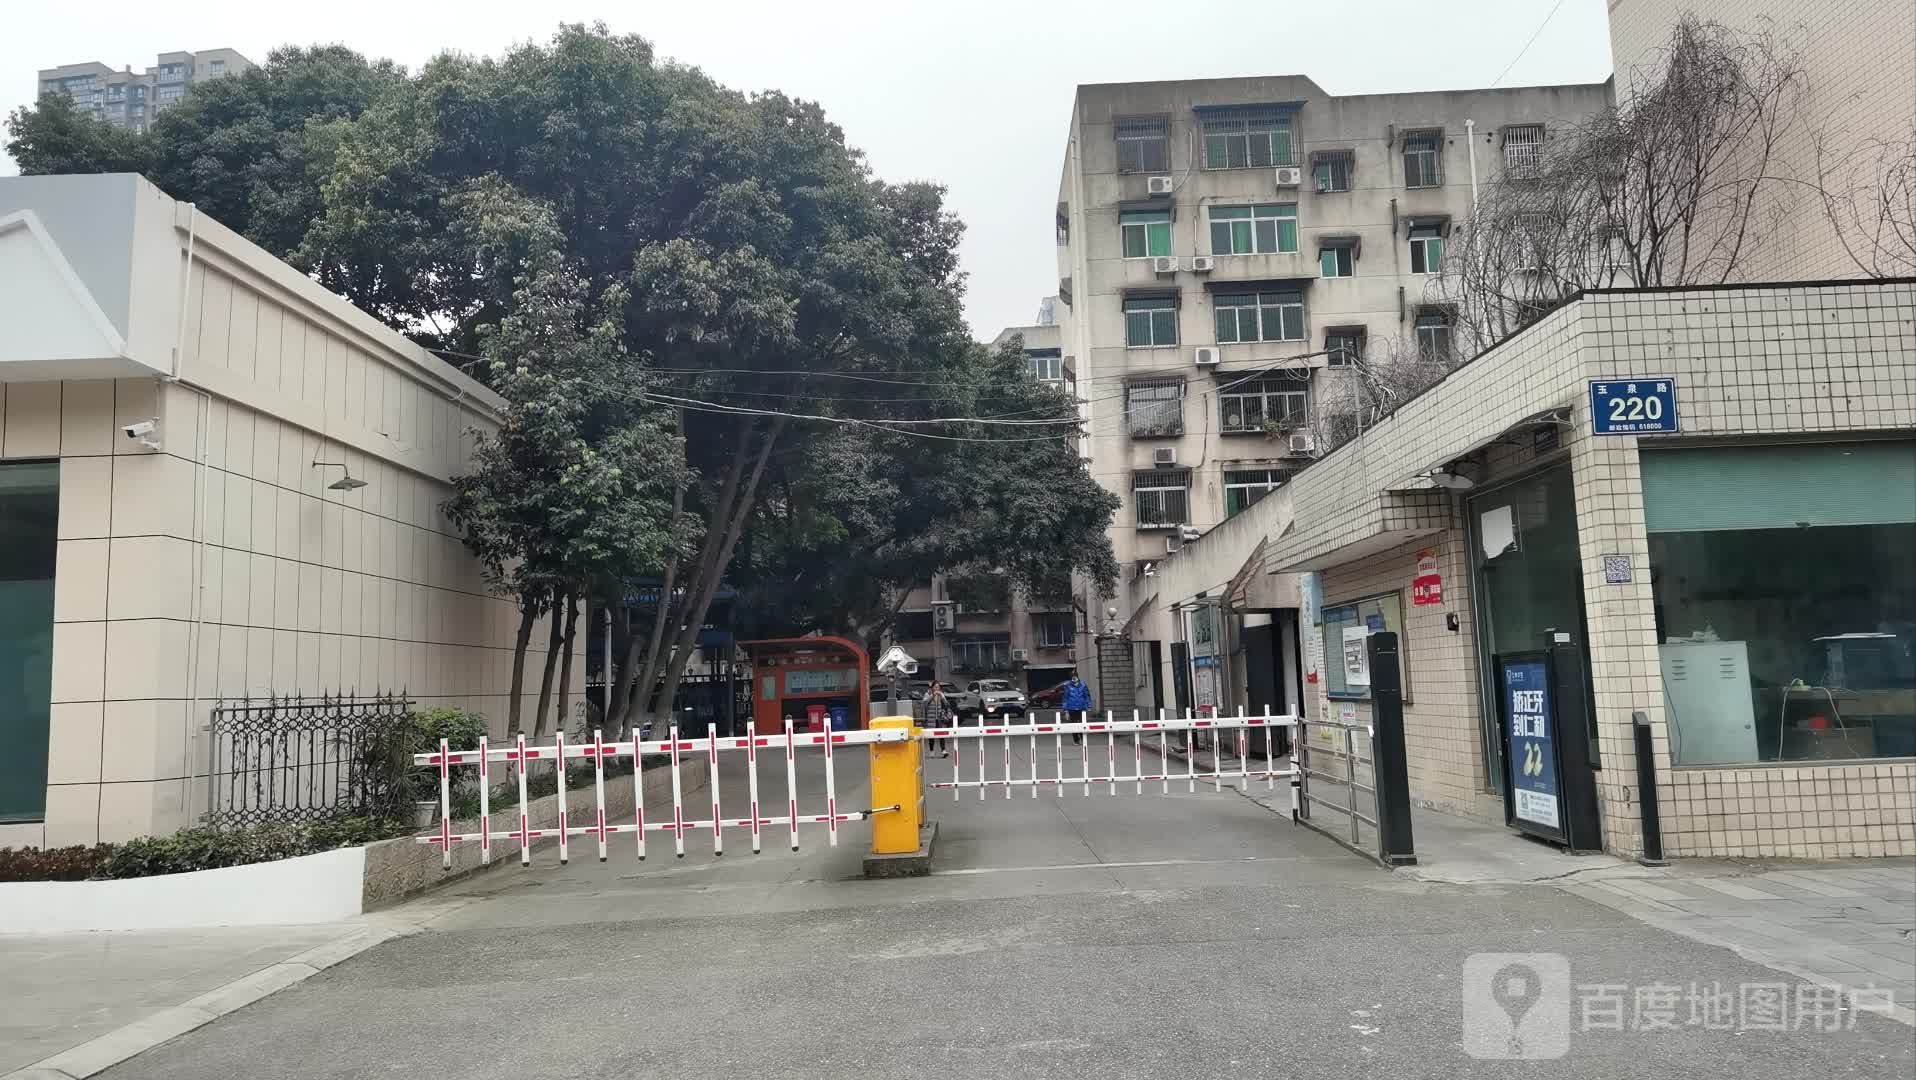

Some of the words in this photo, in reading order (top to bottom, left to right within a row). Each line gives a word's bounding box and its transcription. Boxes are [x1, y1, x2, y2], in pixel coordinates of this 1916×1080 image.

[1598, 383, 1667, 394] 玉泉路
[1609, 396, 1662, 421] 220
[1512, 690, 1544, 714] 矫正牙
[1512, 714, 1545, 738] 到仁和
